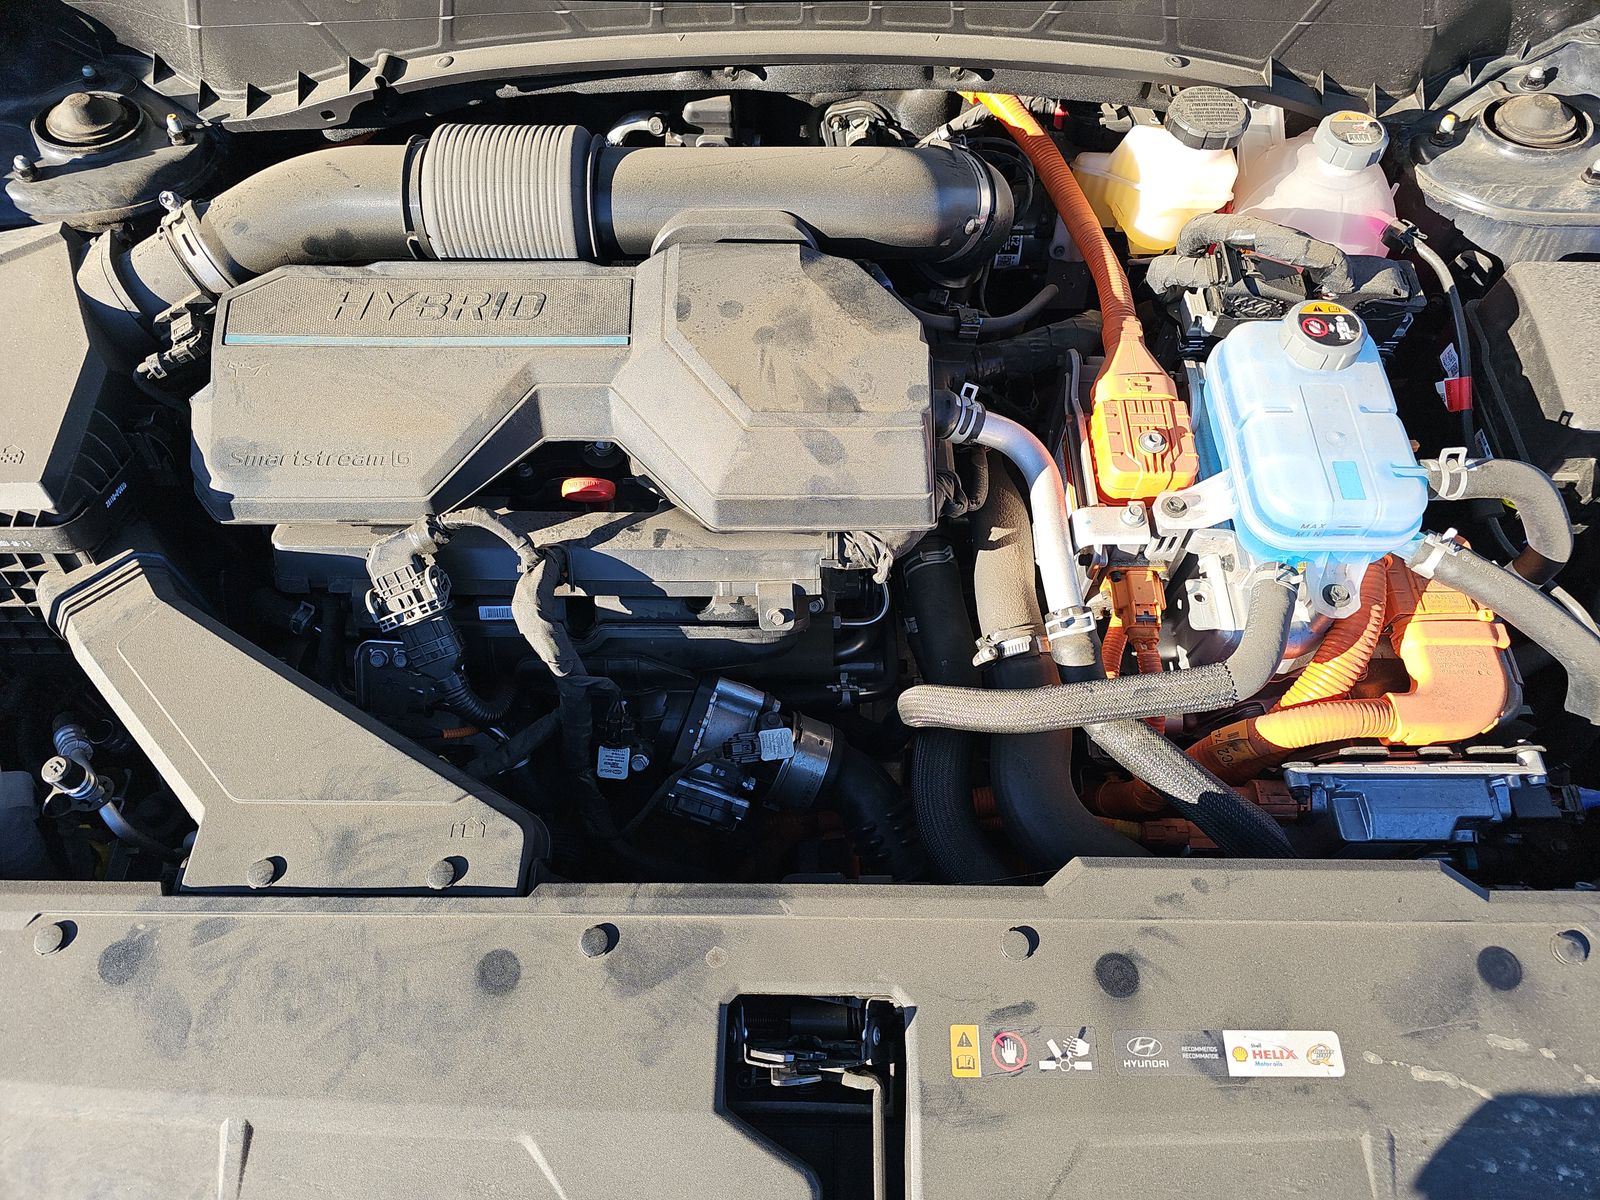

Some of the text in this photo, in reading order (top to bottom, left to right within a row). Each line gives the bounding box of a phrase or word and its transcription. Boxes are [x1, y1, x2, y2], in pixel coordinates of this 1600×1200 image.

[327, 290, 548, 321] HYBRID
[229, 450, 386, 467] Smartstream
[1252, 1049, 1297, 1060] HELIX
[1123, 1059, 1170, 1068] HYUNDAI
